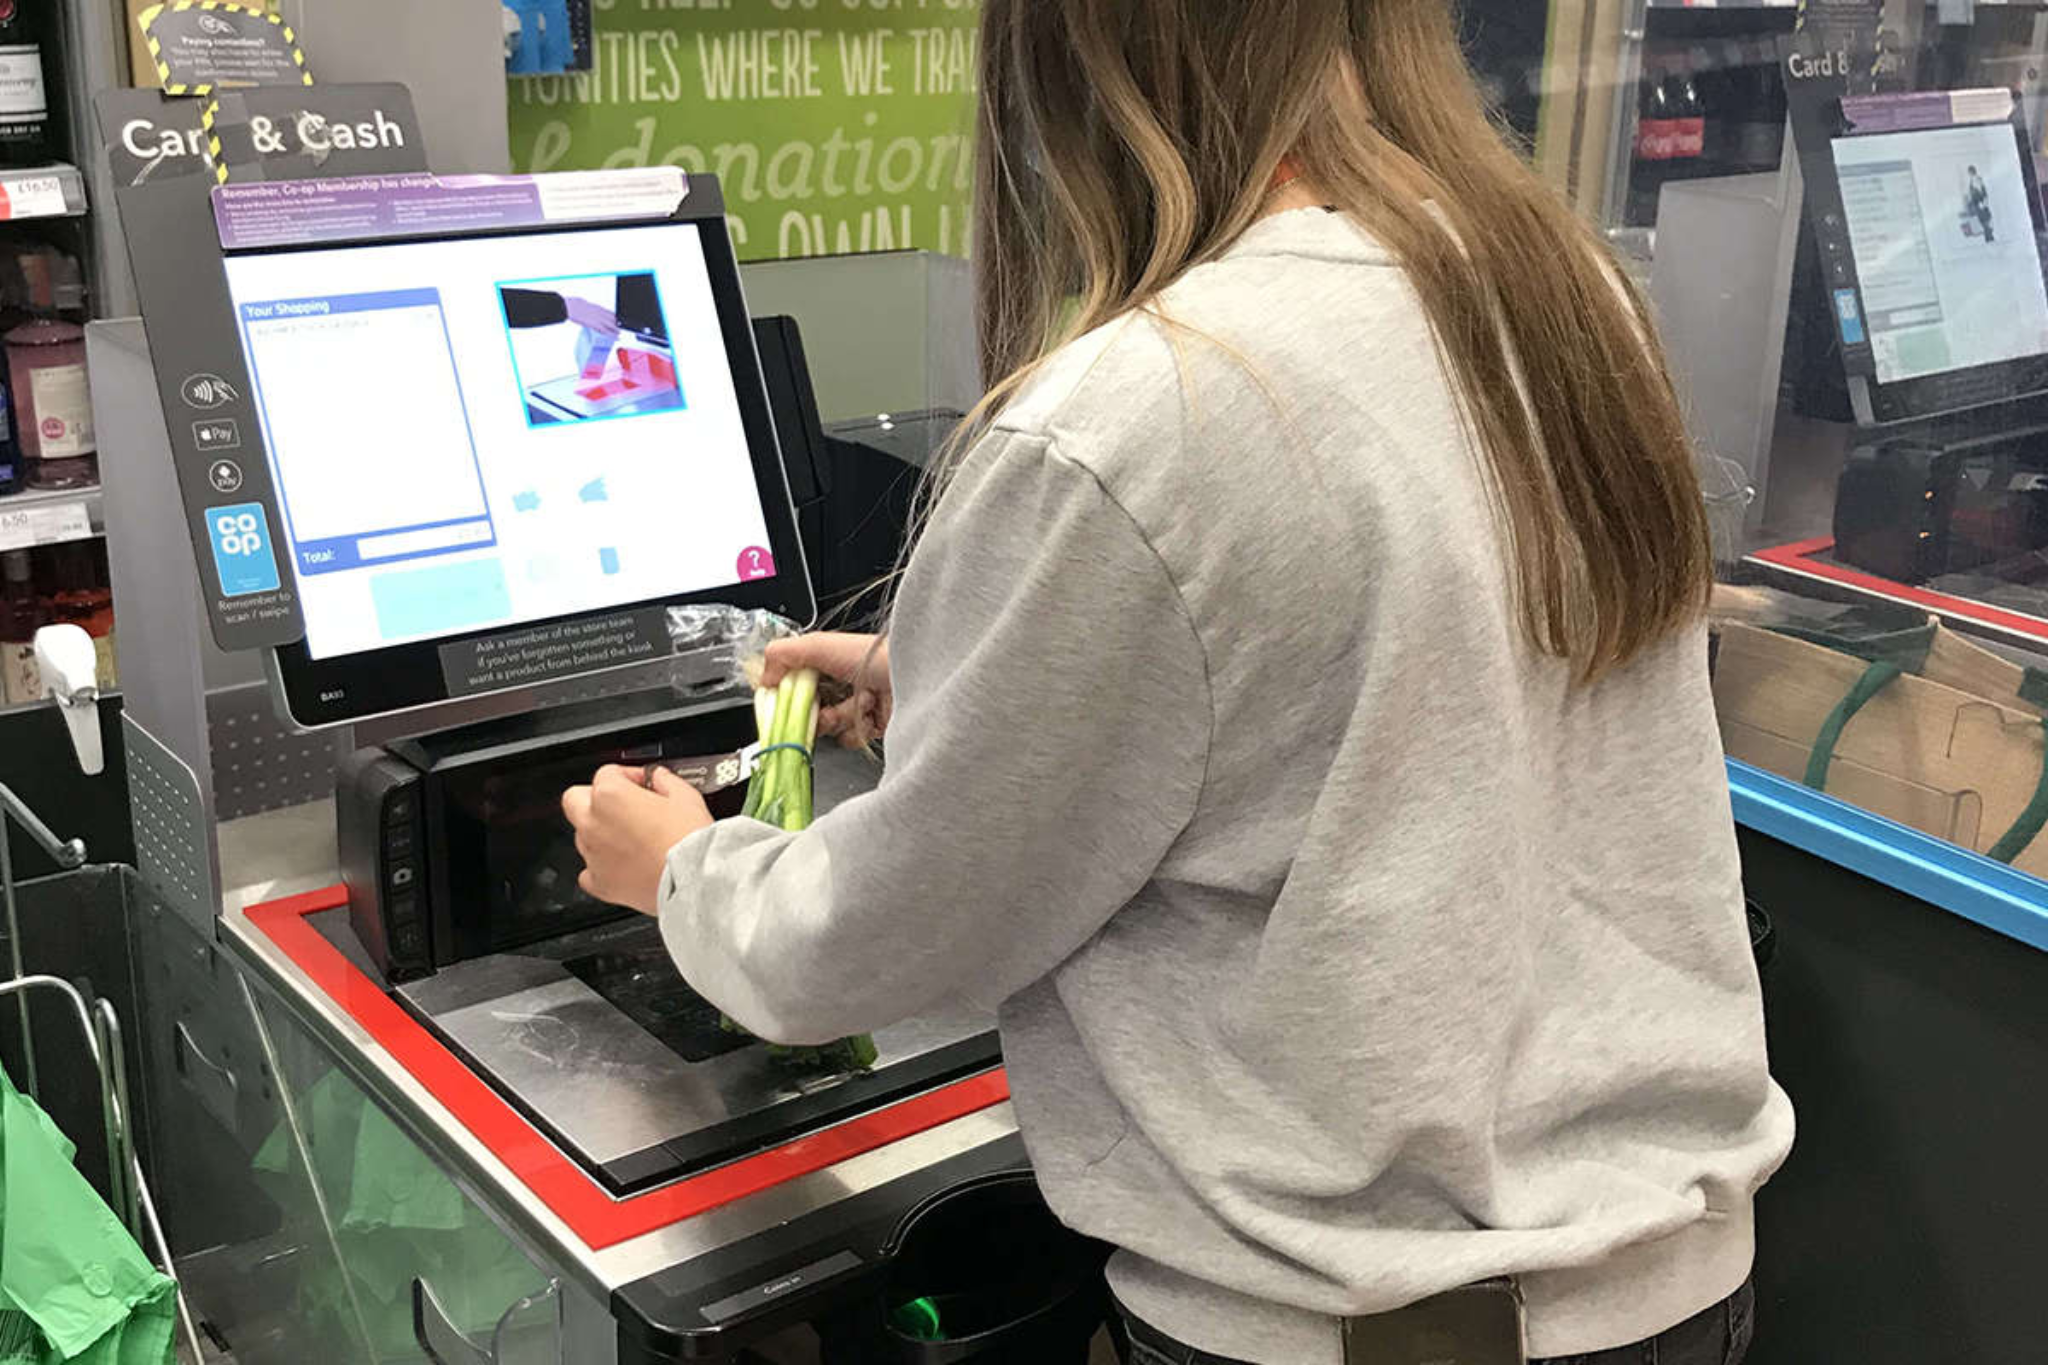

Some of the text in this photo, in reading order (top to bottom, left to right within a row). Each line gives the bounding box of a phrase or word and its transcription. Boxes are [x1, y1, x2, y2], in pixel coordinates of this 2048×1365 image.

[698, 30, 822, 98] WHERE
[839, 29, 894, 96] WE
[1789, 53, 1832, 78] Card
[121, 110, 404, 169] Car & Cash
[246, 300, 330, 318] Your Shopping
[212, 426, 232, 442] Pay
[218, 595, 277, 611] Remember
[476, 640, 494, 652] Ask
[506, 630, 549, 646] member
[551, 627, 561, 638] of
[521, 643, 571, 660] forgotten
[572, 634, 624, 650] something
[468, 671, 494, 685] want
[504, 663, 546, 681] product
[547, 658, 572, 670] from
